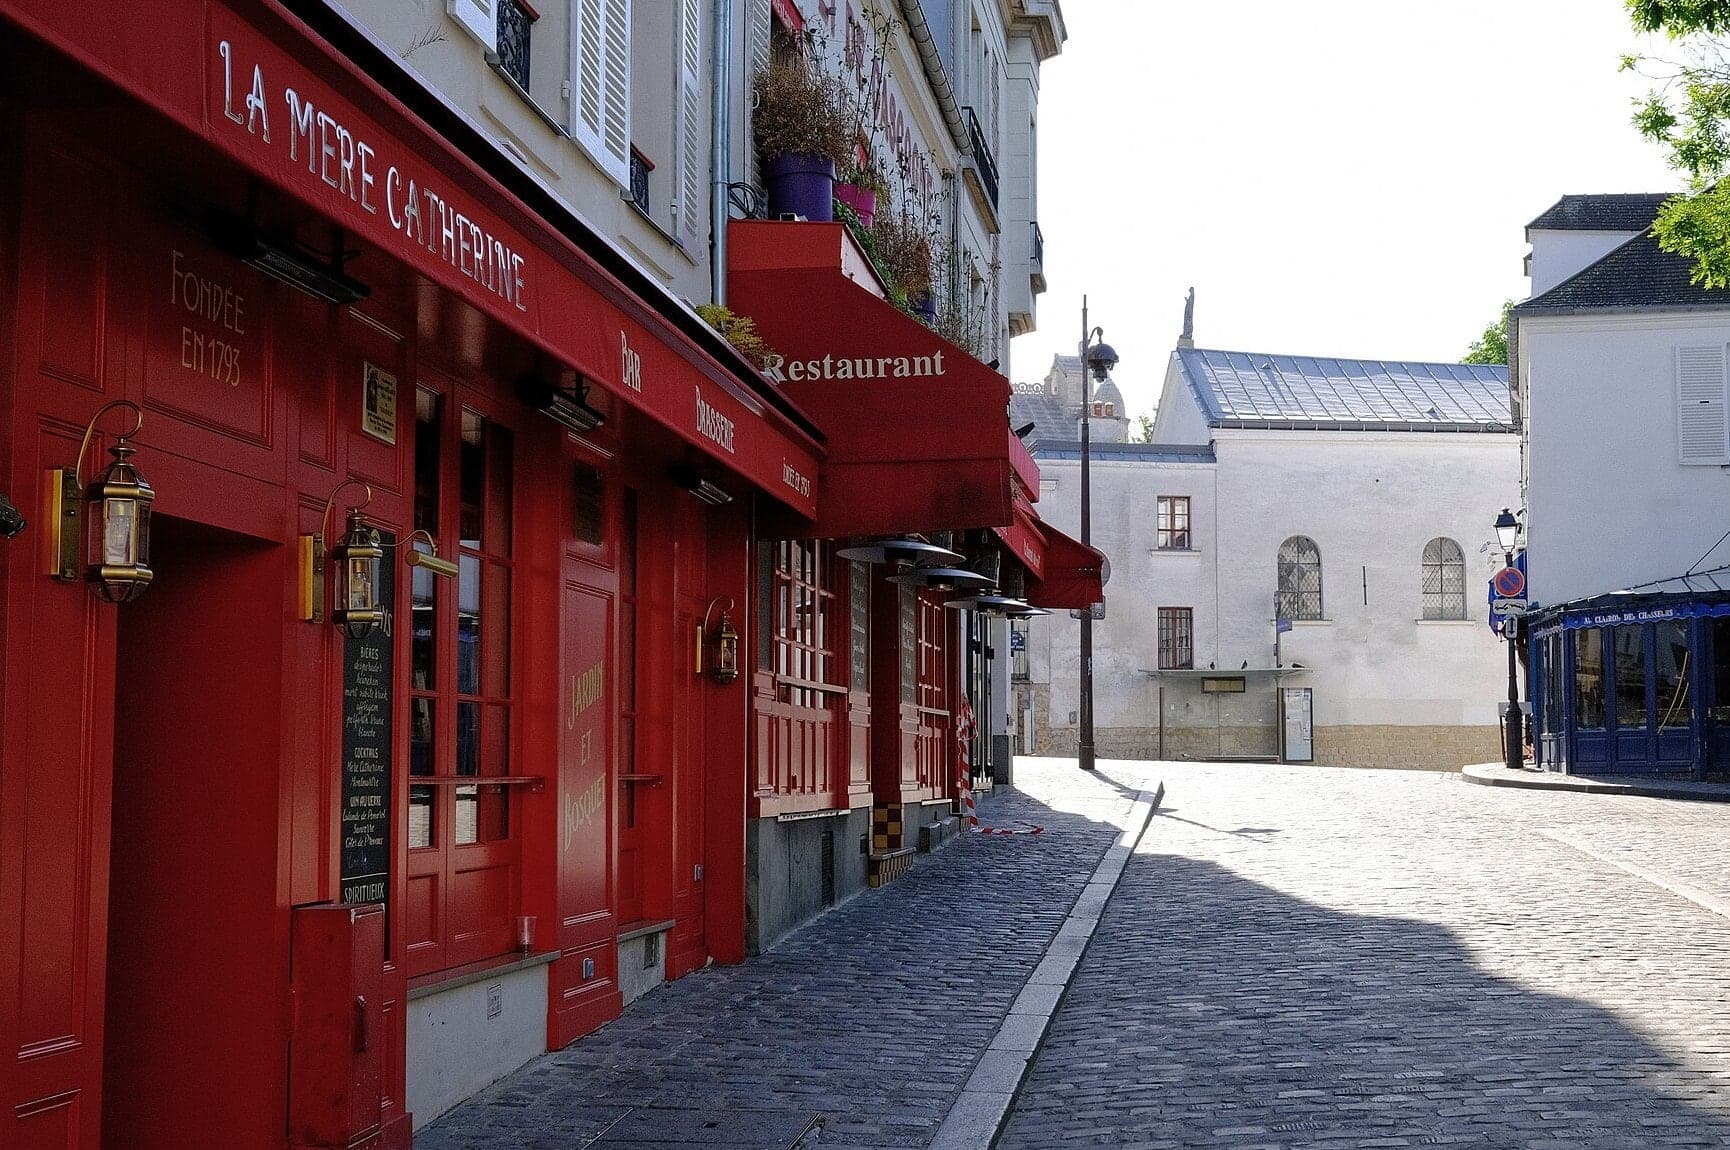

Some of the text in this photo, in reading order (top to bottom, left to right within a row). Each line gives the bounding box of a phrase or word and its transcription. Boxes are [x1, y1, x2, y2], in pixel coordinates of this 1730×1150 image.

[219, 40, 527, 312] LA MERE CATHERINE
[171, 249, 245, 335] FONDÉE
[182, 326, 241, 387] EN 1793
[620, 330, 641, 394] BAR
[760, 350, 946, 384] Restaurant
[695, 385, 735, 454] BRASSERIE
[567, 659, 603, 730] JARDIN
[580, 729, 592, 766] ET
[344, 882, 385, 905] SPIRITUEUX
